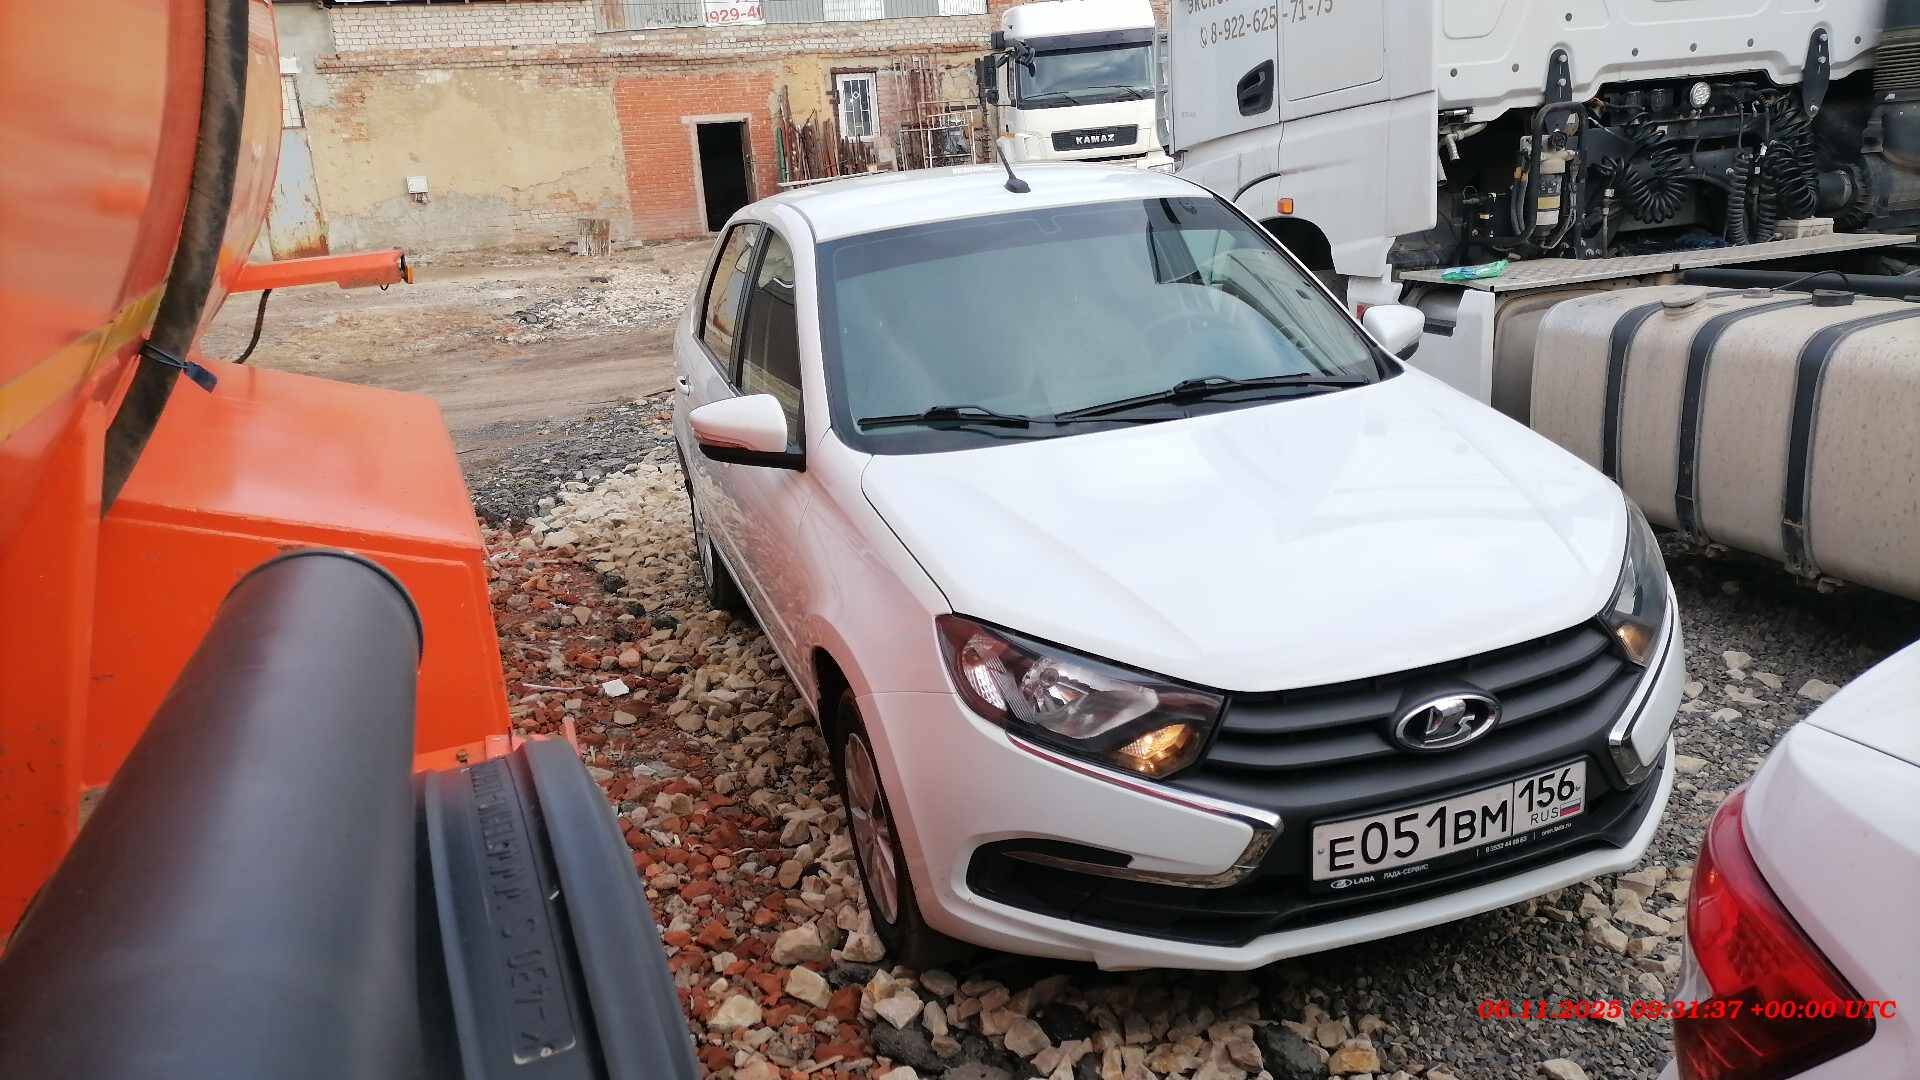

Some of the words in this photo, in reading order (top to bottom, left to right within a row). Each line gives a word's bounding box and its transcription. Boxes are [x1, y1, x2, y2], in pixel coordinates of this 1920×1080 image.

[1075, 134, 1115, 145] KAMAZ
[1518, 768, 1576, 812] 156
[1531, 806, 1559, 826] RUS
[1353, 876, 1375, 885] LADA
